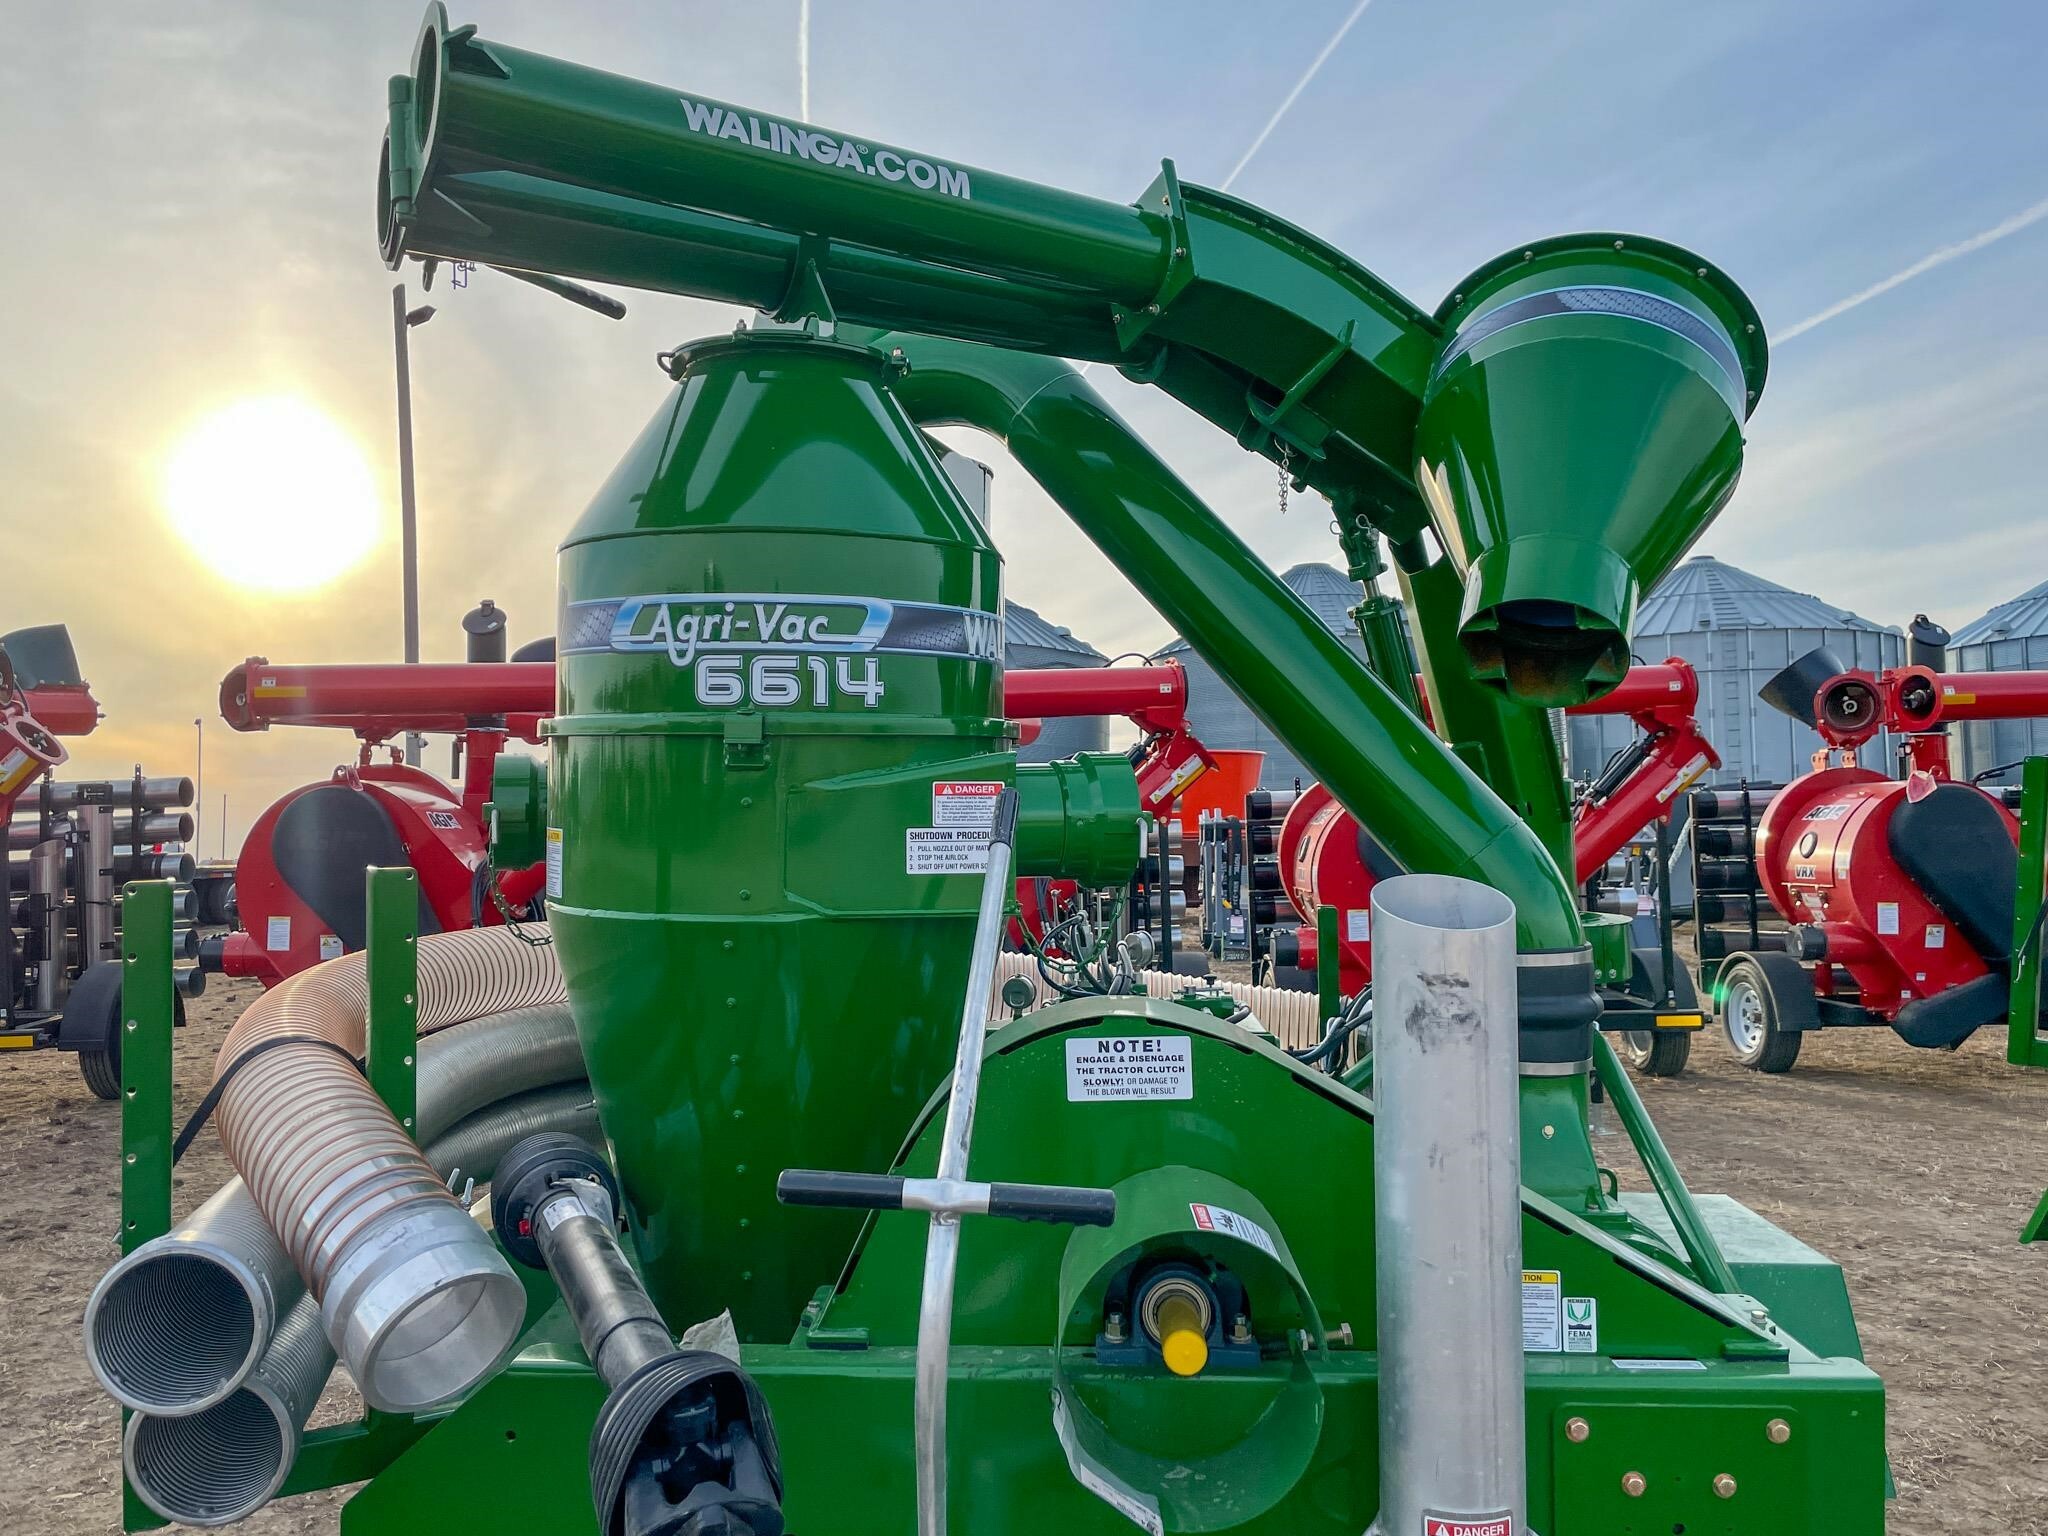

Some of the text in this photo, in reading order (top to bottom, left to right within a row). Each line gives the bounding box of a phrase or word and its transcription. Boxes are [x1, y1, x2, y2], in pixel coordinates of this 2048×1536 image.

[645, 602, 829, 667] Agri-Vac
[695, 655, 885, 708] 6614
[955, 785, 995, 794] DANGER
[909, 831, 953, 840] SHUTDOWN
[1795, 866, 1815, 878] VRX
[1098, 1040, 1161, 1053] NOTE!
[1076, 1067, 1095, 1075] THE
[1098, 1066, 1143, 1074] TRACTOR
[1083, 1078, 1124, 1086] SLOWLY!
[1139, 1077, 1168, 1085] DAMAGE
[1087, 1088, 1099, 1096] THE
[1132, 1087, 1148, 1095] WILL
[1453, 1524, 1505, 1536] DANGER
